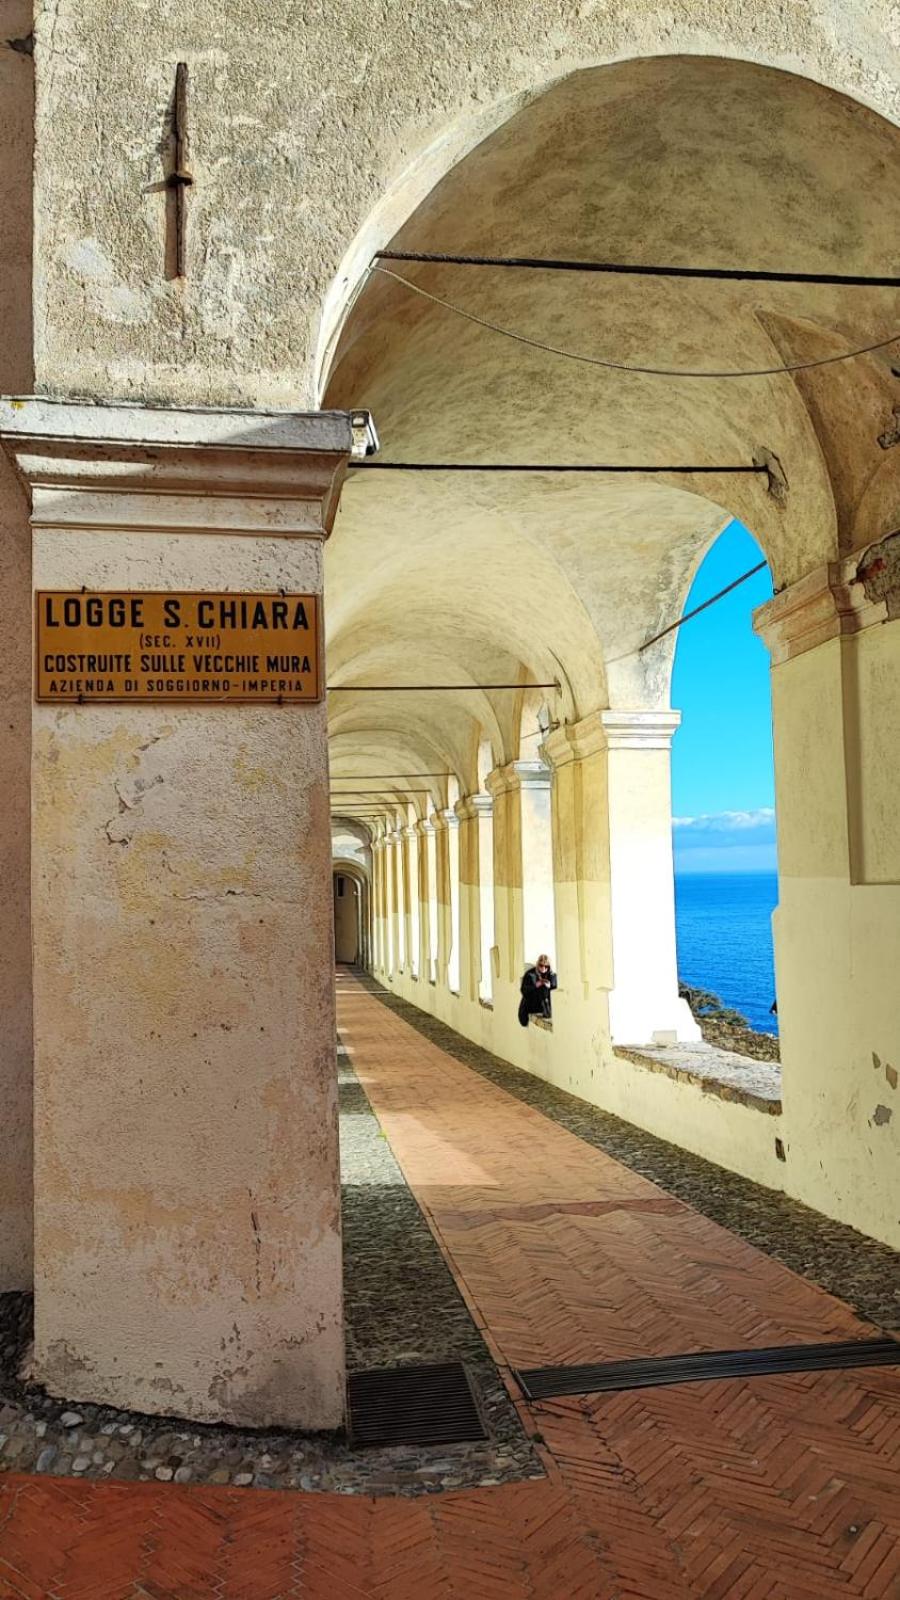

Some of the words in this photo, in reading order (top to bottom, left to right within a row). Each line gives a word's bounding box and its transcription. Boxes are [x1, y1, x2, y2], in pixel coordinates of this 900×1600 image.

[46, 598, 144, 627] LOGGE
[139, 633, 176, 650] (SEC.
[186, 634, 221, 650] XVII)
[44, 654, 131, 673] COSTRUITE
[140, 654, 185, 673] SULLE
[193, 655, 259, 673] VECCHIE
[267, 655, 311, 673] MURA
[49, 679, 115, 692] AZIENDA
[125, 679, 138, 692] DI
